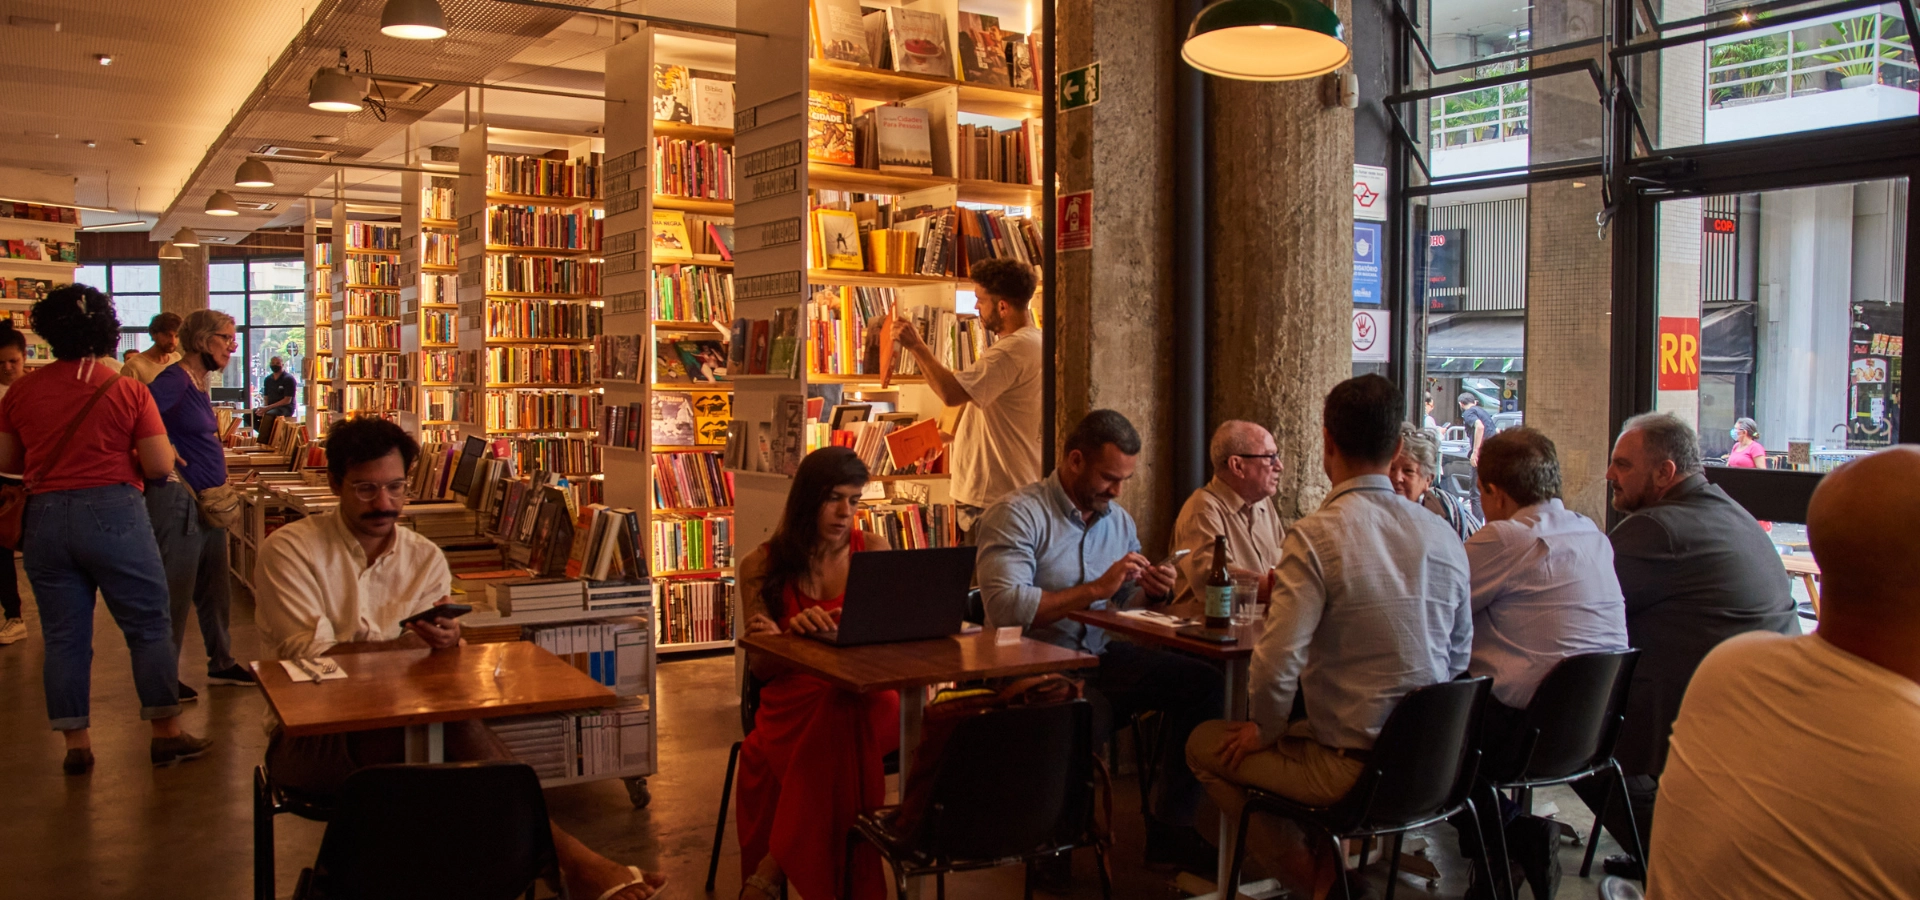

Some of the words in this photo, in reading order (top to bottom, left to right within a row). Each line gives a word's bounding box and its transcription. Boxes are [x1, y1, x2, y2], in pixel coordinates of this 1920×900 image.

[811, 112, 842, 123] CIDADE
[897, 116, 923, 124] Cidades
[883, 120, 897, 128] Para
[898, 121, 923, 130] Pessoas
[1661, 332, 1697, 375] RR
